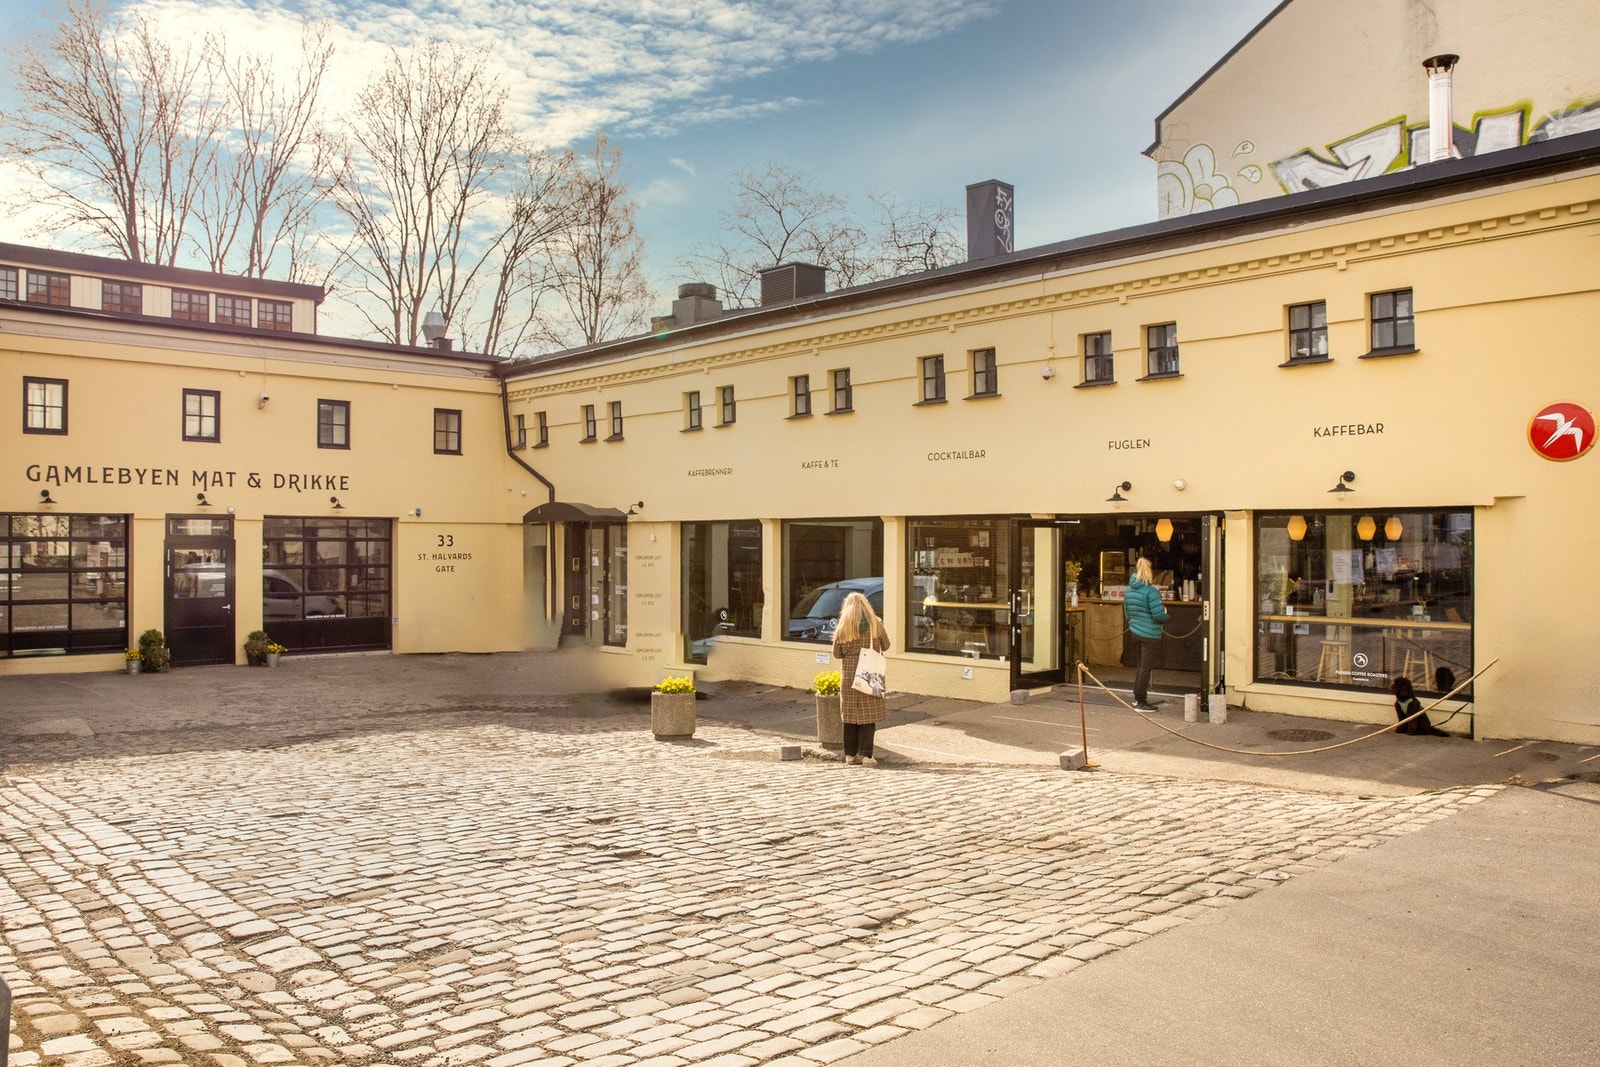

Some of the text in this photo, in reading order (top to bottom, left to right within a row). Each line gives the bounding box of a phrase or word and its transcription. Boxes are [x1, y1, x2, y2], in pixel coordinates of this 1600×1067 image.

[1313, 422, 1384, 437] KAFFEBAR
[1108, 439, 1151, 450] FUGLEN
[927, 449, 986, 461] COCKTAILBAR
[801, 459, 839, 469] KAFFE & TE
[687, 467, 733, 477] KAFFEBRENNERI
[25, 464, 349, 493] GAMLEBYEN MAT & DRIKKE
[437, 534, 454, 547] 33
[432, 552, 472, 560] HALVARDS
[435, 565, 455, 573] GATE
